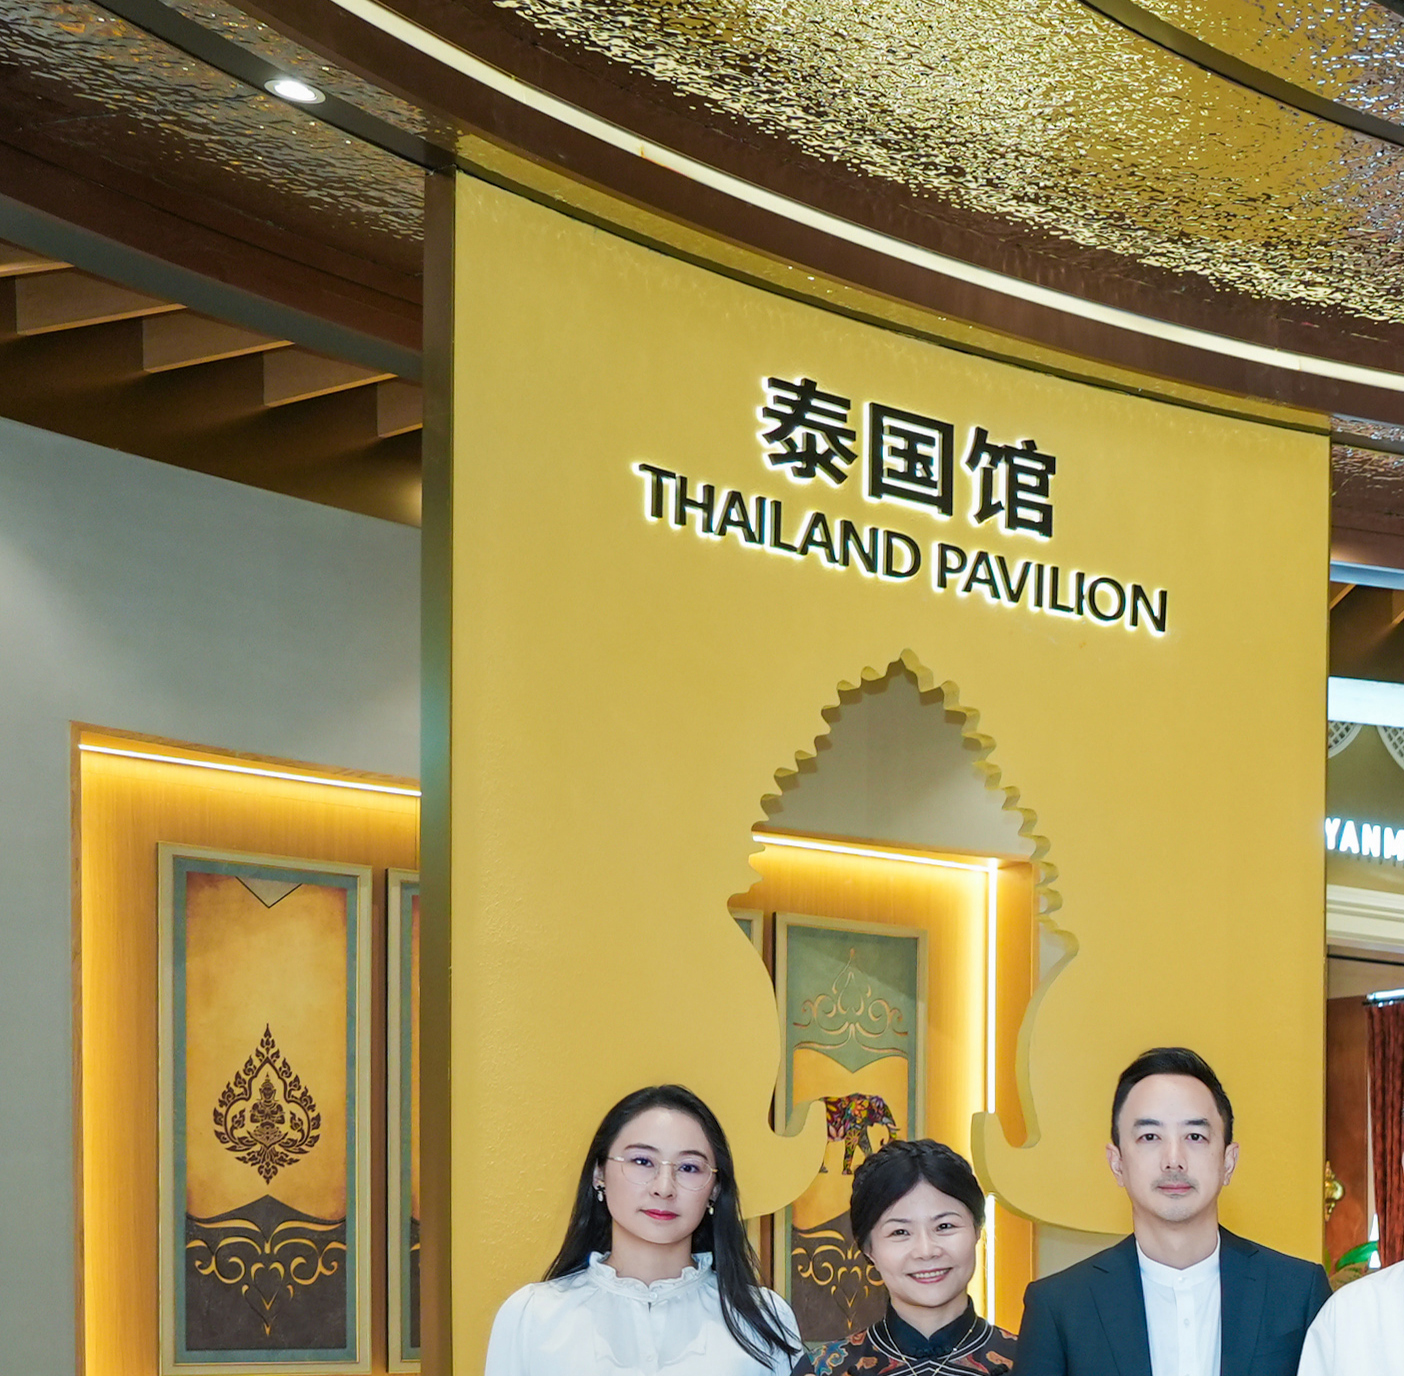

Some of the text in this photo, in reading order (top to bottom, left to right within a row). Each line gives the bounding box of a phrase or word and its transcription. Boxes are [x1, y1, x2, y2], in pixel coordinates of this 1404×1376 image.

[760, 376, 1057, 538] 泰国馆
[636, 462, 1169, 633] THAILAND PAVILION
